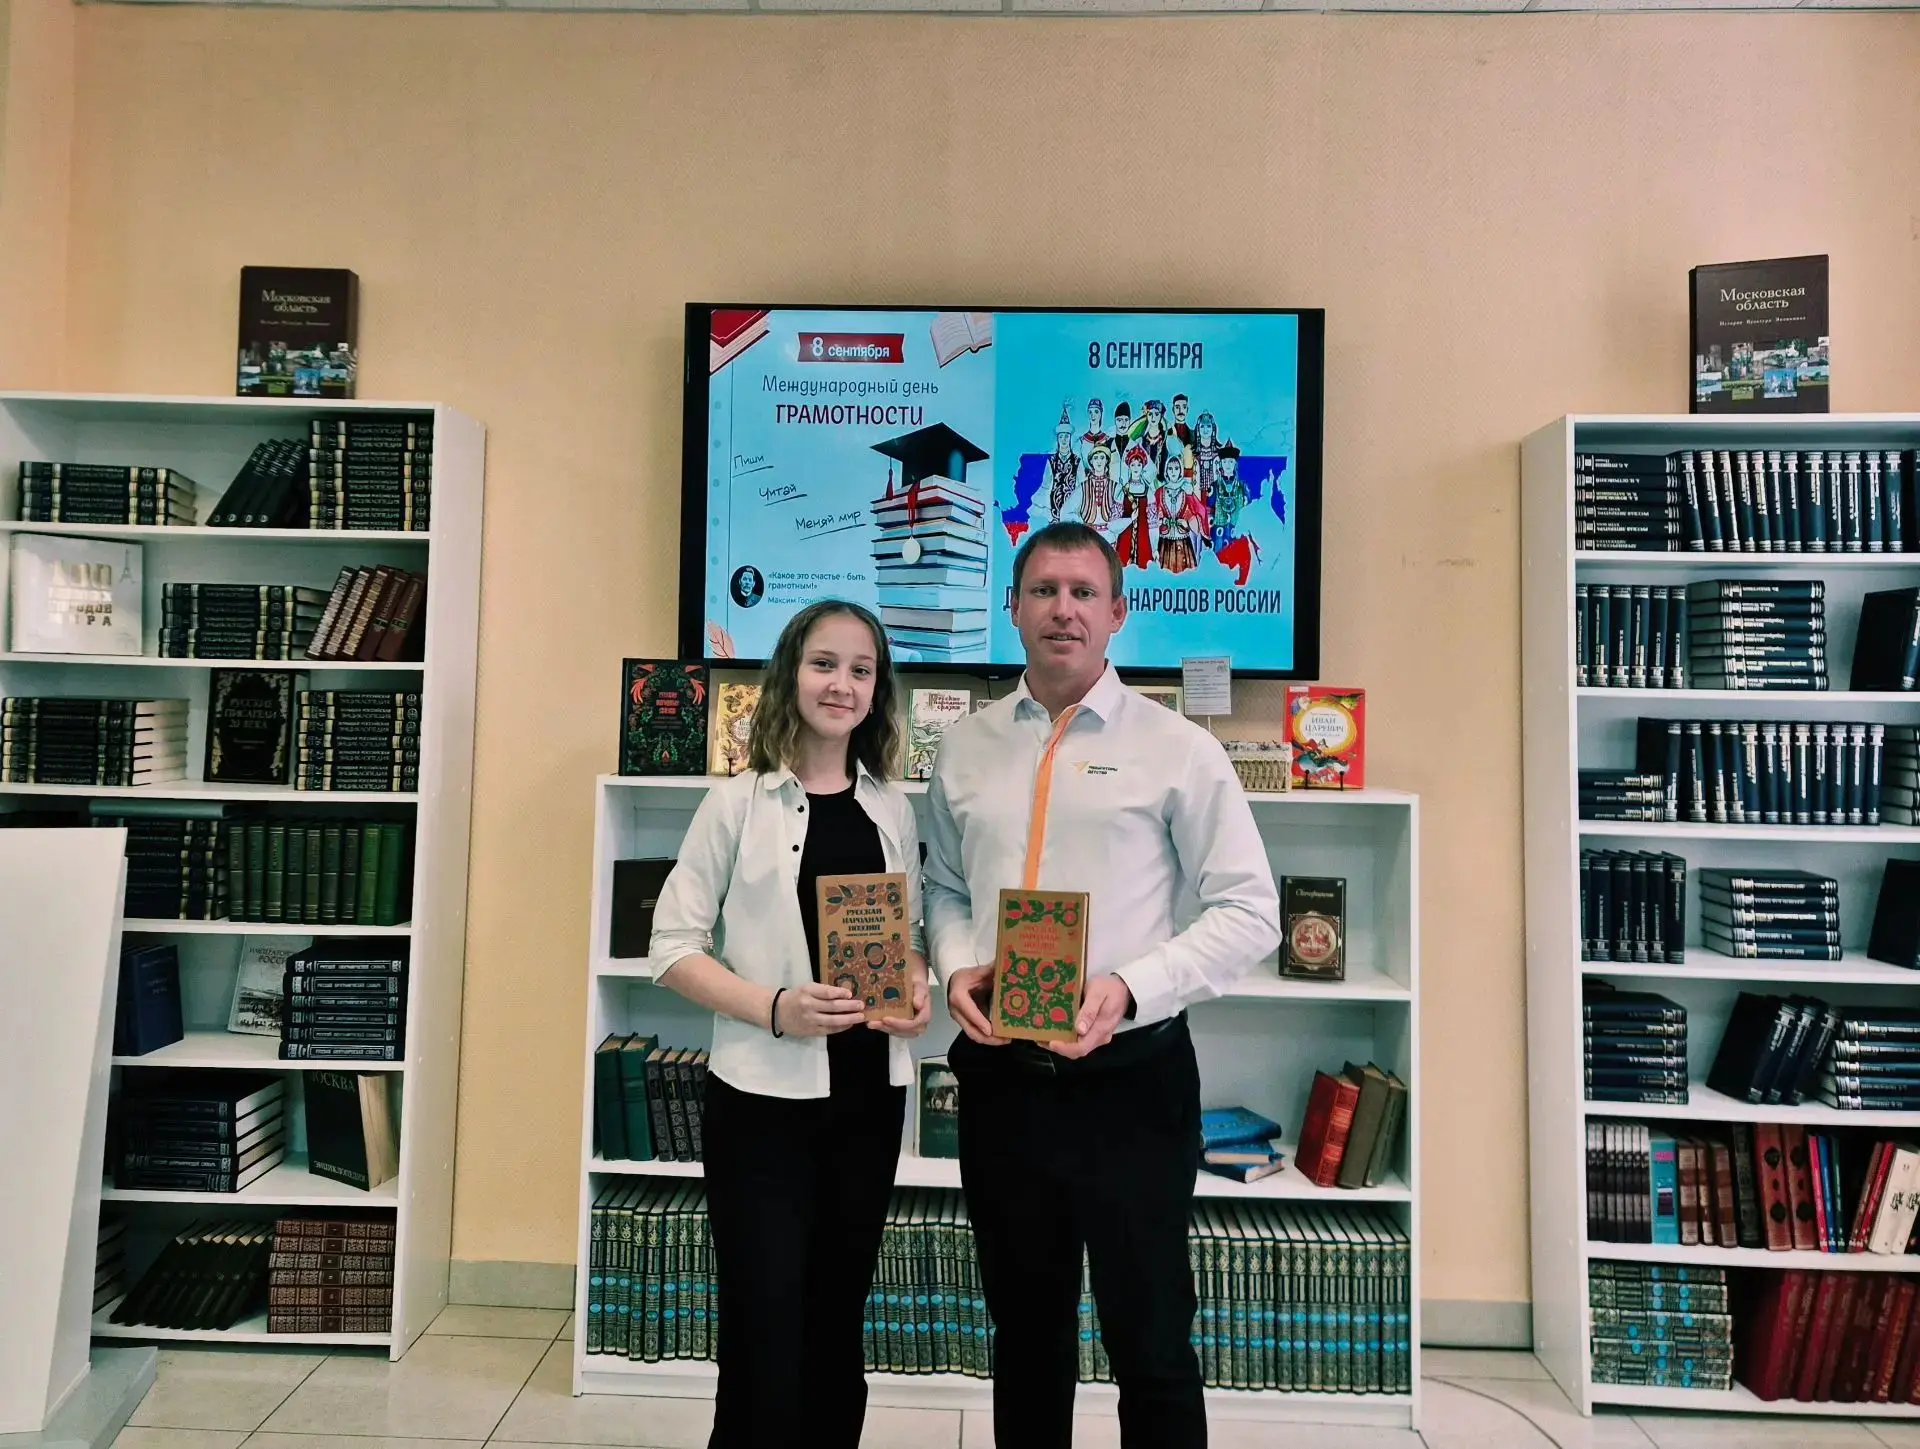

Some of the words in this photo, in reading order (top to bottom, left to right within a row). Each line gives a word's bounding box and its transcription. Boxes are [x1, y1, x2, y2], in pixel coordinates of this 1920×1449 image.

[262, 290, 331, 304] Московская
[1720, 287, 1806, 302] Московская
[274, 303, 318, 313] область
[1736, 298, 1790, 312] область
[812, 336, 824, 357] 8
[828, 344, 890, 358] сентября
[1088, 342, 1101, 369] 8
[1106, 342, 1202, 370] СЕНТЯБРЯ
[762, 375, 898, 396] Международный
[902, 382, 939, 397] день
[776, 404, 923, 426] ГРАМОТНОСТИ
[734, 454, 764, 468] Пиши
[758, 484, 798, 499] Читай
[795, 515, 836, 531] Меняй
[839, 510, 862, 526] мир
[1129, 588, 1208, 615] НАРОДОВ
[1214, 588, 1281, 614] РОССИИ
